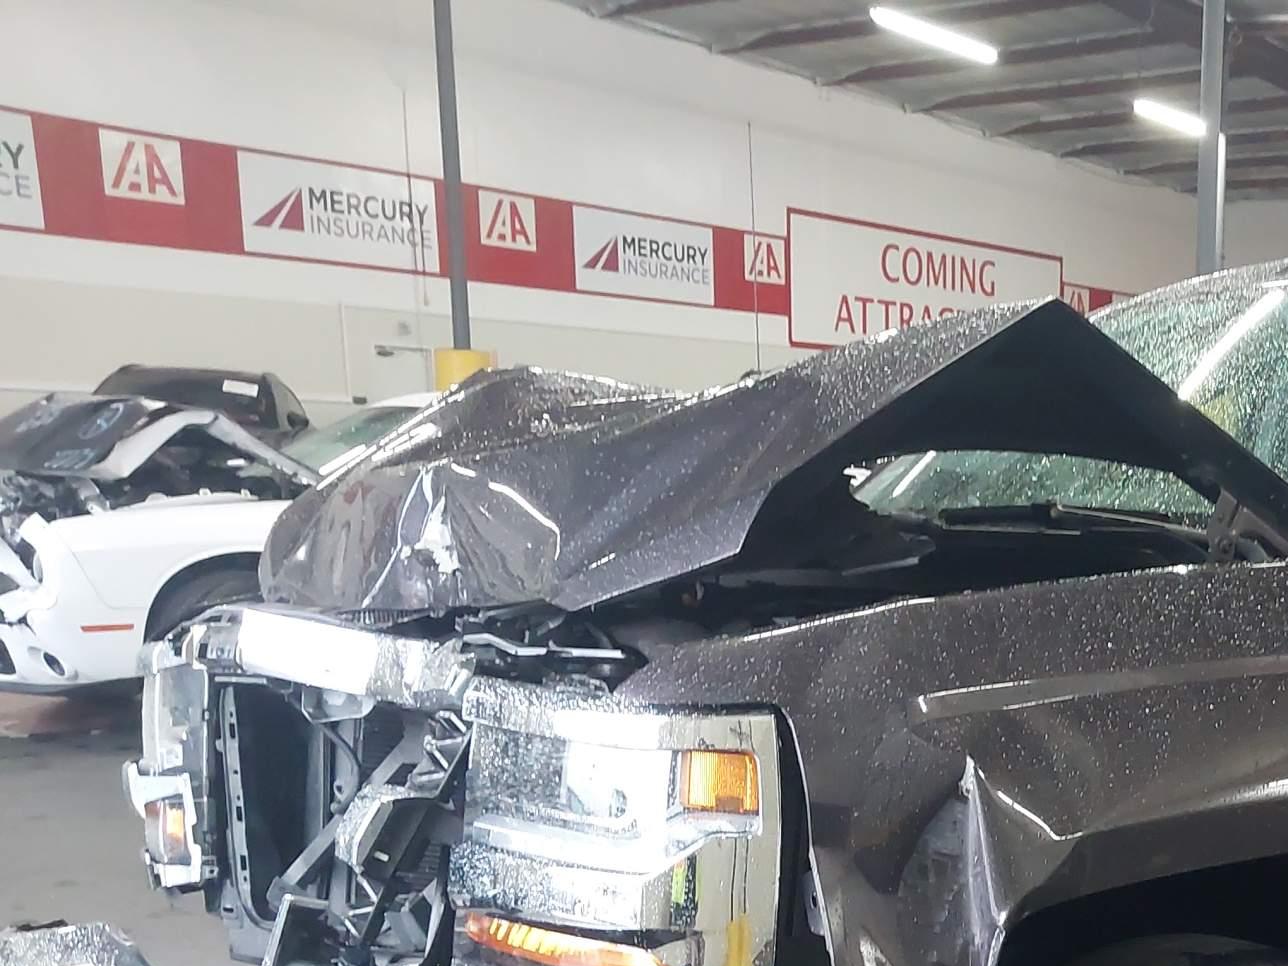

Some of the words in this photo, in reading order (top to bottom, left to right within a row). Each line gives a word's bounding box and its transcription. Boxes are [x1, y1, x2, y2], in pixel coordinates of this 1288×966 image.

[307, 186, 429, 226] MERCURY
[309, 215, 433, 251] INSURANCE
[622, 235, 708, 266] MERCURY
[622, 258, 711, 285] INSURANCE
[881, 243, 996, 297] COMING
